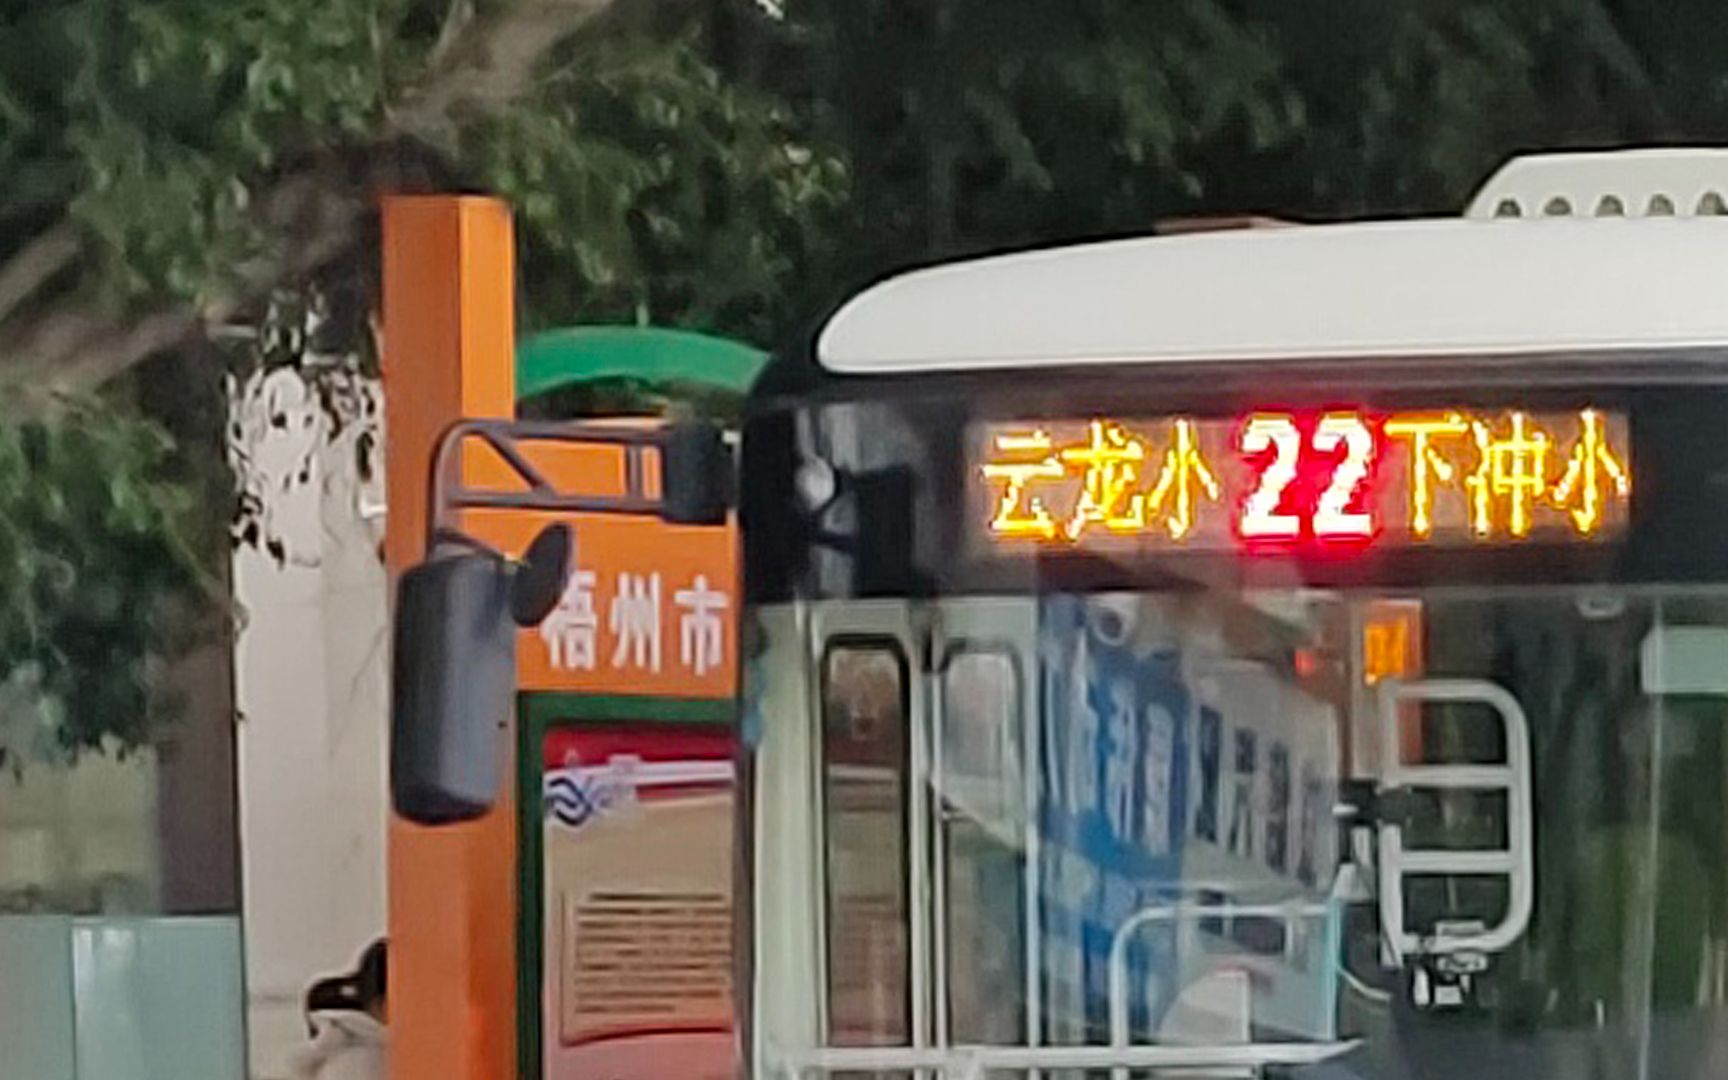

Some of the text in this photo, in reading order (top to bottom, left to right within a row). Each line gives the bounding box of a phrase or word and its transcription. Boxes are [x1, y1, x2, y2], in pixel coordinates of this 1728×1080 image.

[982, 408, 1630, 540] 云龙小 22 下冲小
